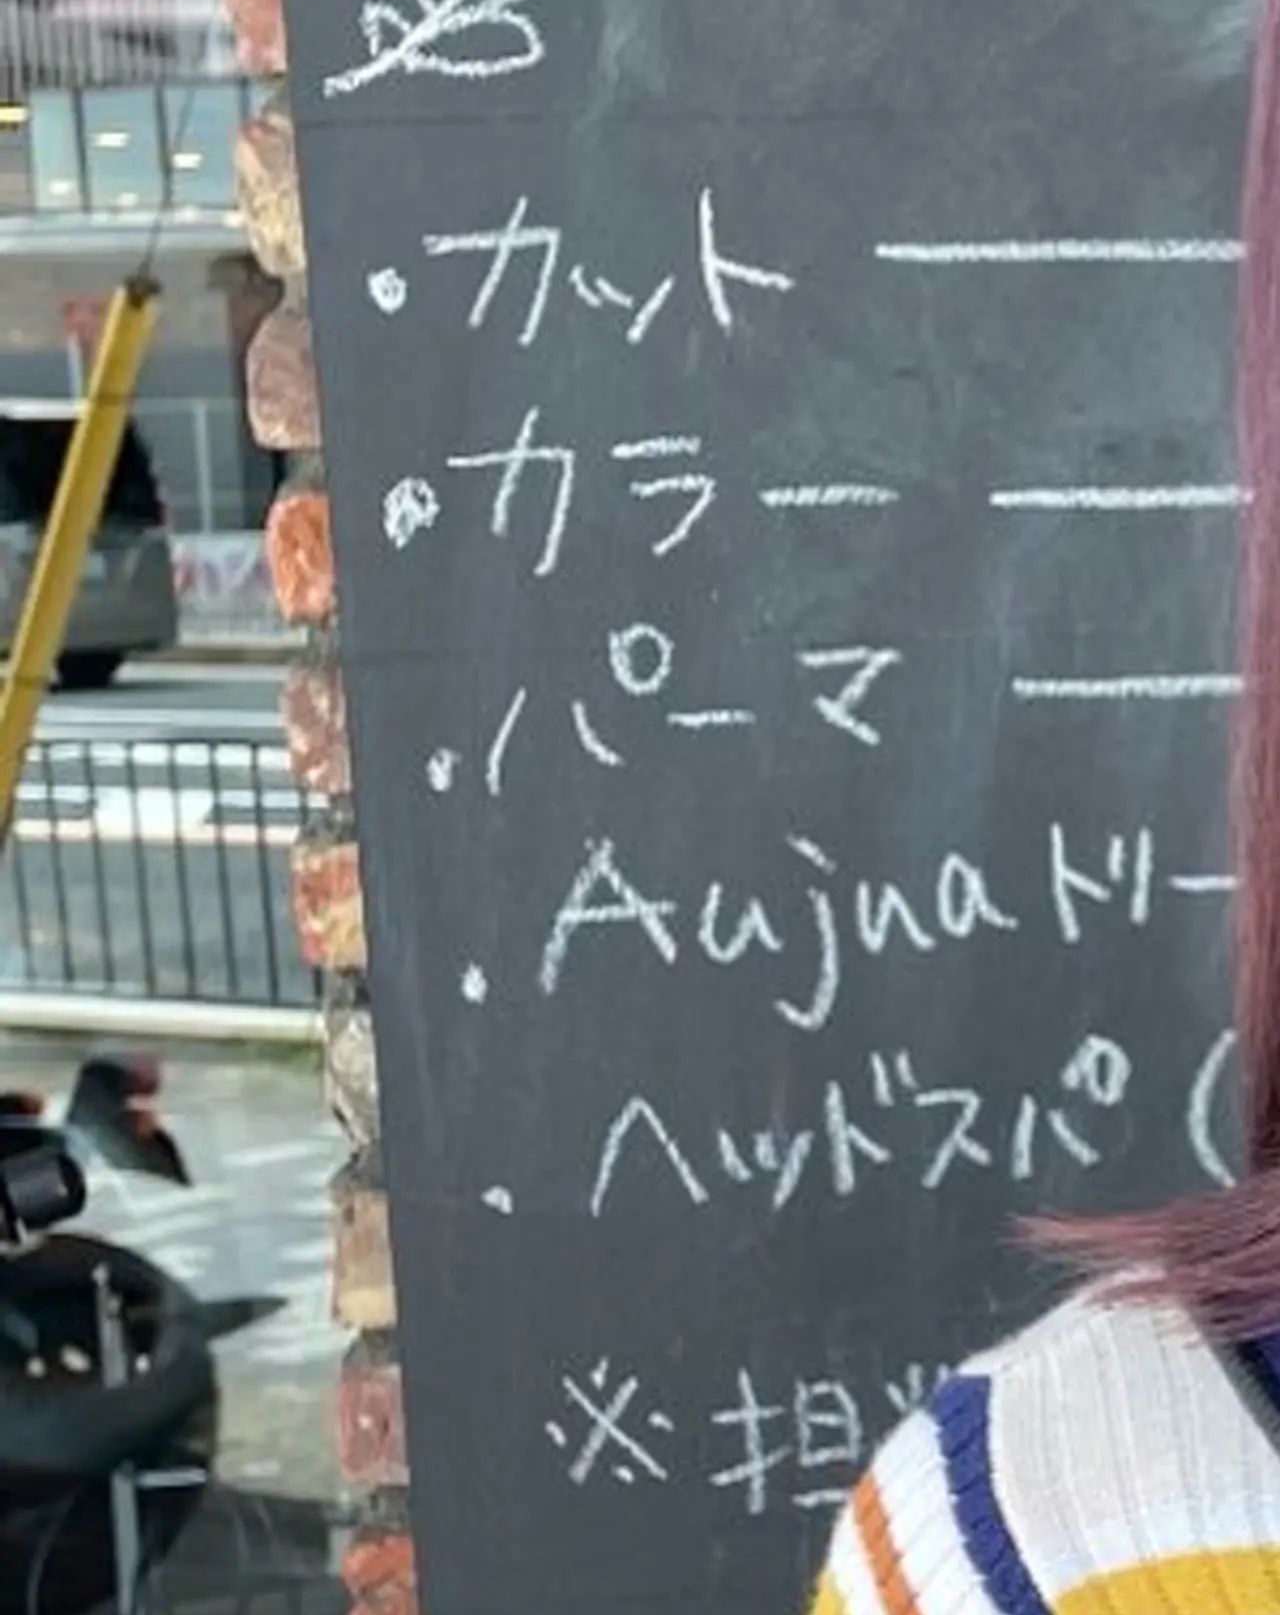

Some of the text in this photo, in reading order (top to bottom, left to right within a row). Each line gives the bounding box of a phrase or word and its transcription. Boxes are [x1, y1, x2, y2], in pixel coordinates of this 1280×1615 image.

[422, 188, 796, 346] カット
[485, 622, 902, 796] パーマ
